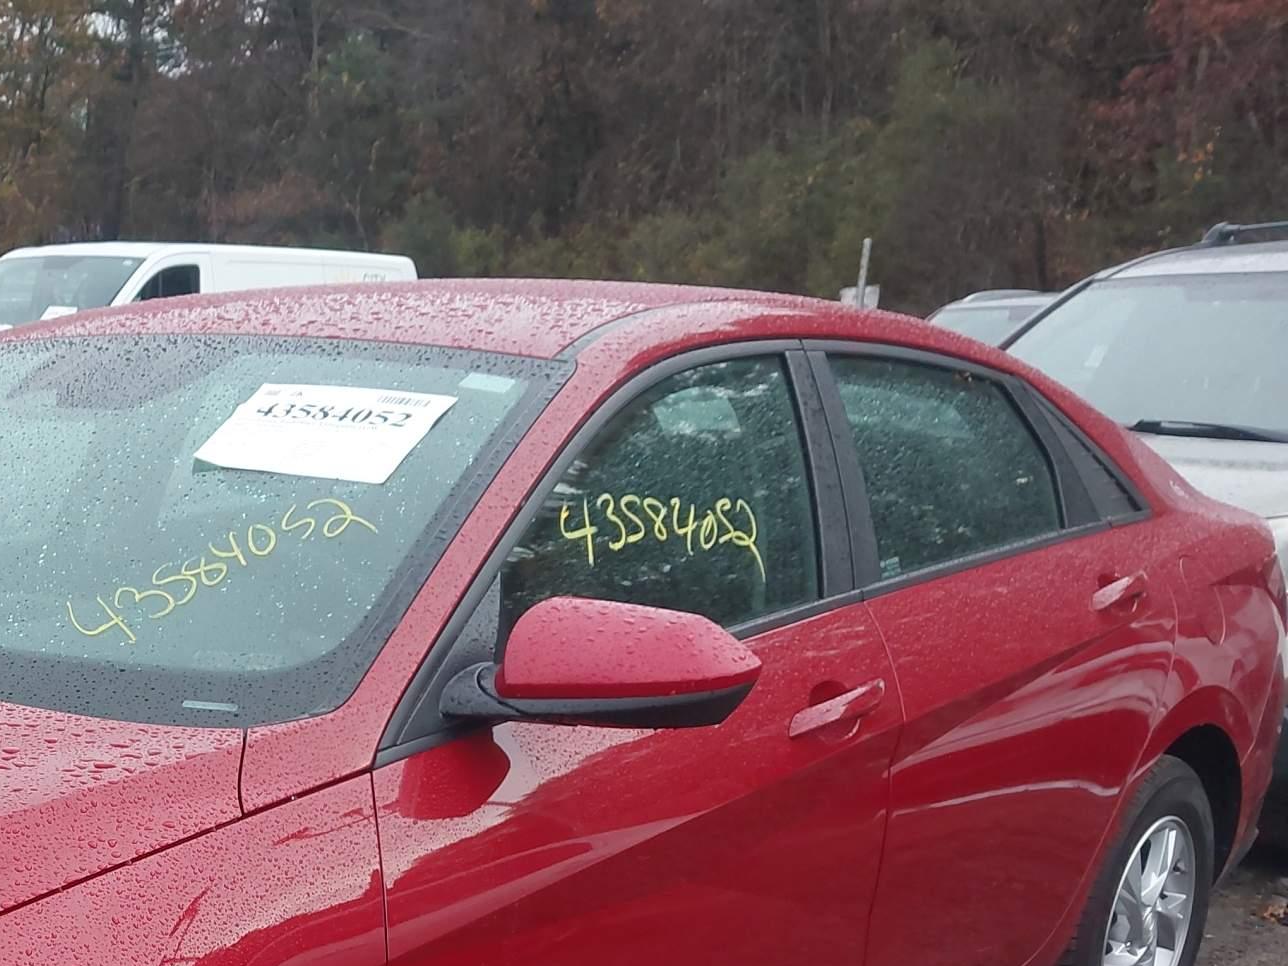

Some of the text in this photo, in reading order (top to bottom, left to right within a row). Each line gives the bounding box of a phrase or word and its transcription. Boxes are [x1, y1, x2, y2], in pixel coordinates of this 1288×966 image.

[256, 402, 413, 428] 43584052
[67, 498, 378, 645] 43584052
[560, 493, 766, 584] 43584052
